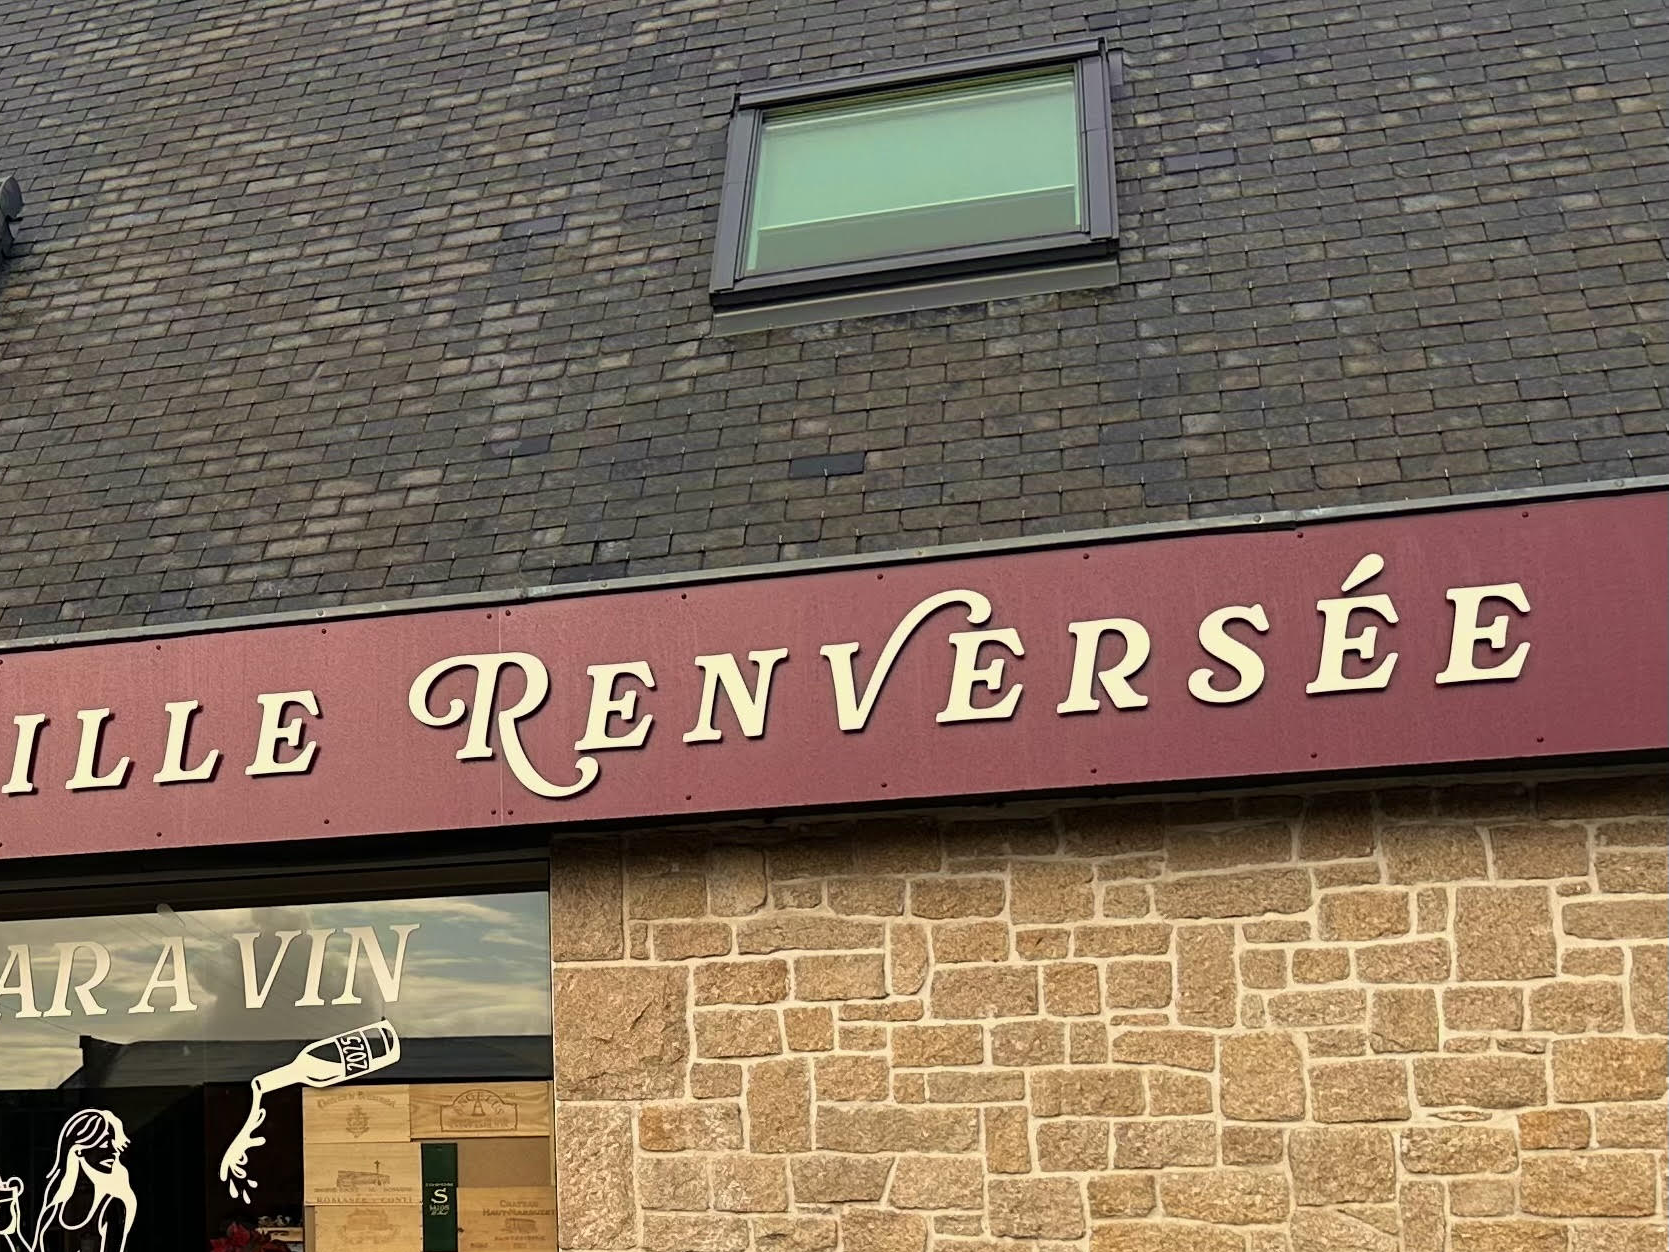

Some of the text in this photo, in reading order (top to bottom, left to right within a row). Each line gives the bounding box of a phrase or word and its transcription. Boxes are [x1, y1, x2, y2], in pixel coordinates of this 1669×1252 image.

[408, 553, 1532, 800] RENVERSÉE
[232, 924, 421, 1009] VIN
[340, 1036, 368, 1071] 2025
